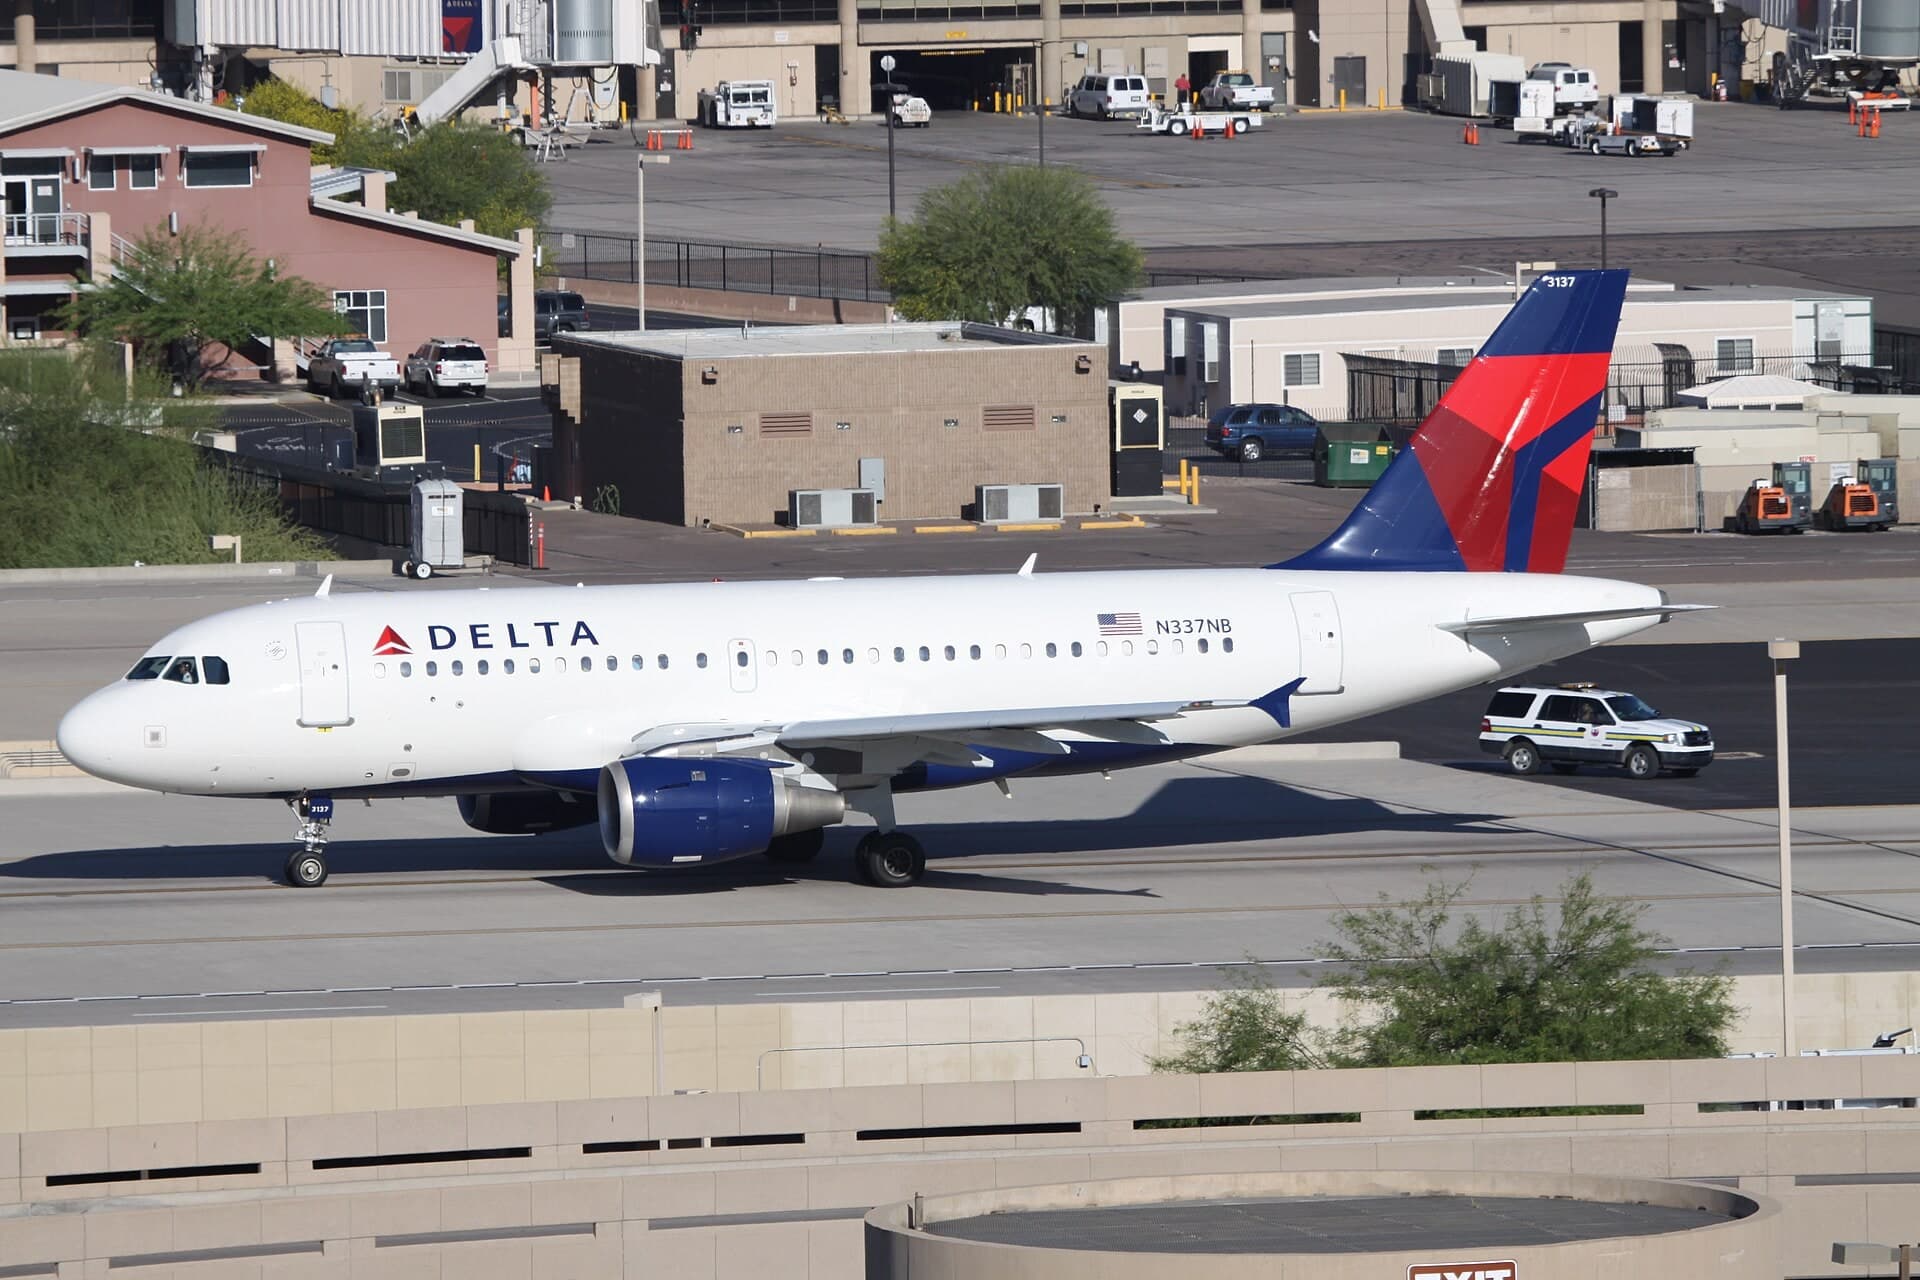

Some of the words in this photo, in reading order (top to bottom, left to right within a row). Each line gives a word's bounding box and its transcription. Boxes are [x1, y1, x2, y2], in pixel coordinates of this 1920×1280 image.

[1547, 276, 1576, 288] 3137
[427, 620, 600, 650] DELTA
[1156, 619, 1232, 635] N337NB
